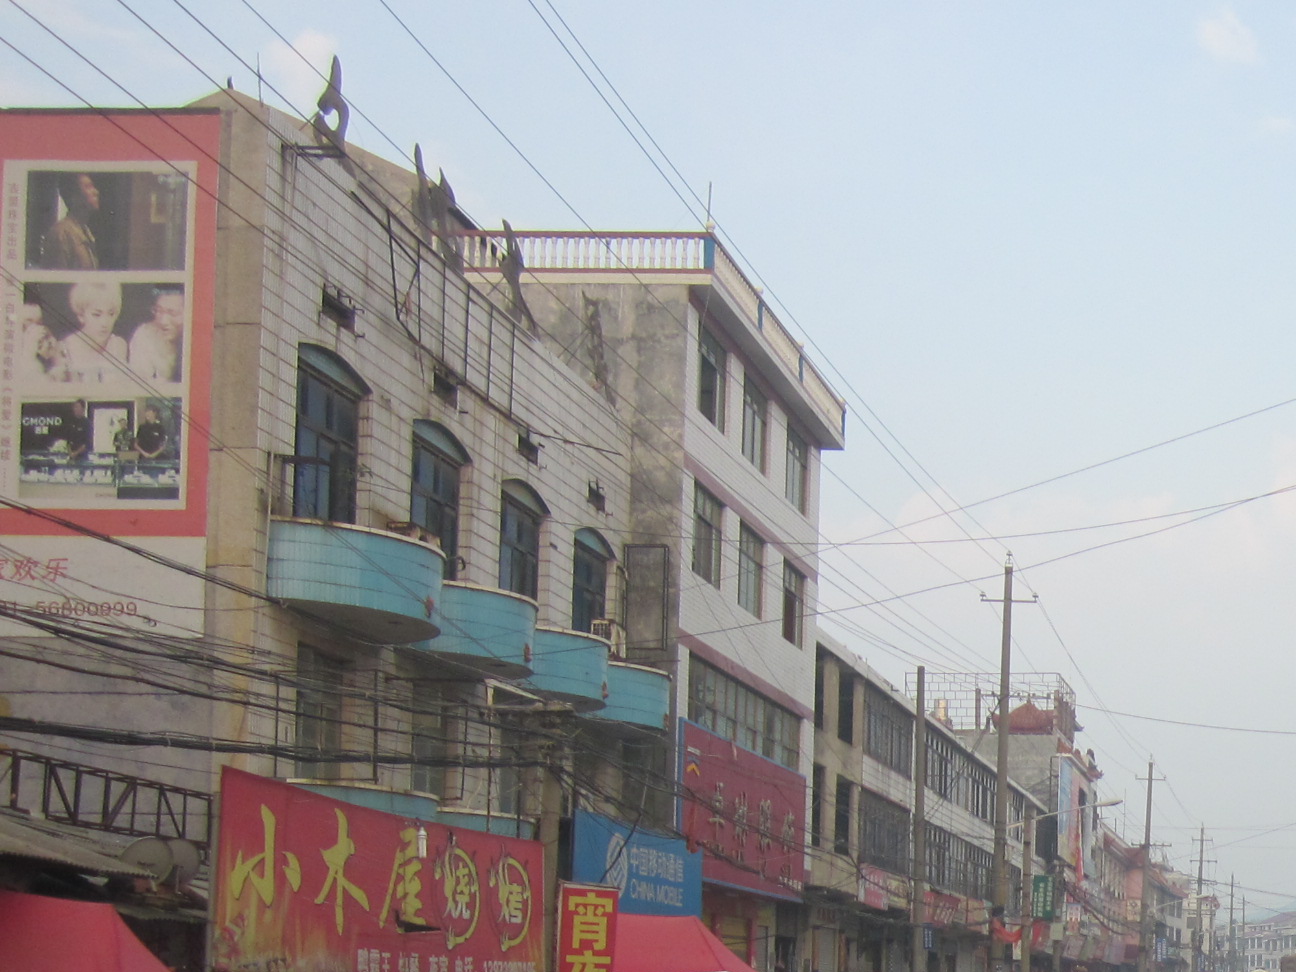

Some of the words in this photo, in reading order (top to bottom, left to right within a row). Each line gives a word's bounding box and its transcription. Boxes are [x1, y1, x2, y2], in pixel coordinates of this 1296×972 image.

[630, 844, 684, 882] 中国移动通信
[630, 878, 656, 903] CHINA
[656, 884, 684, 907] MOBILE
